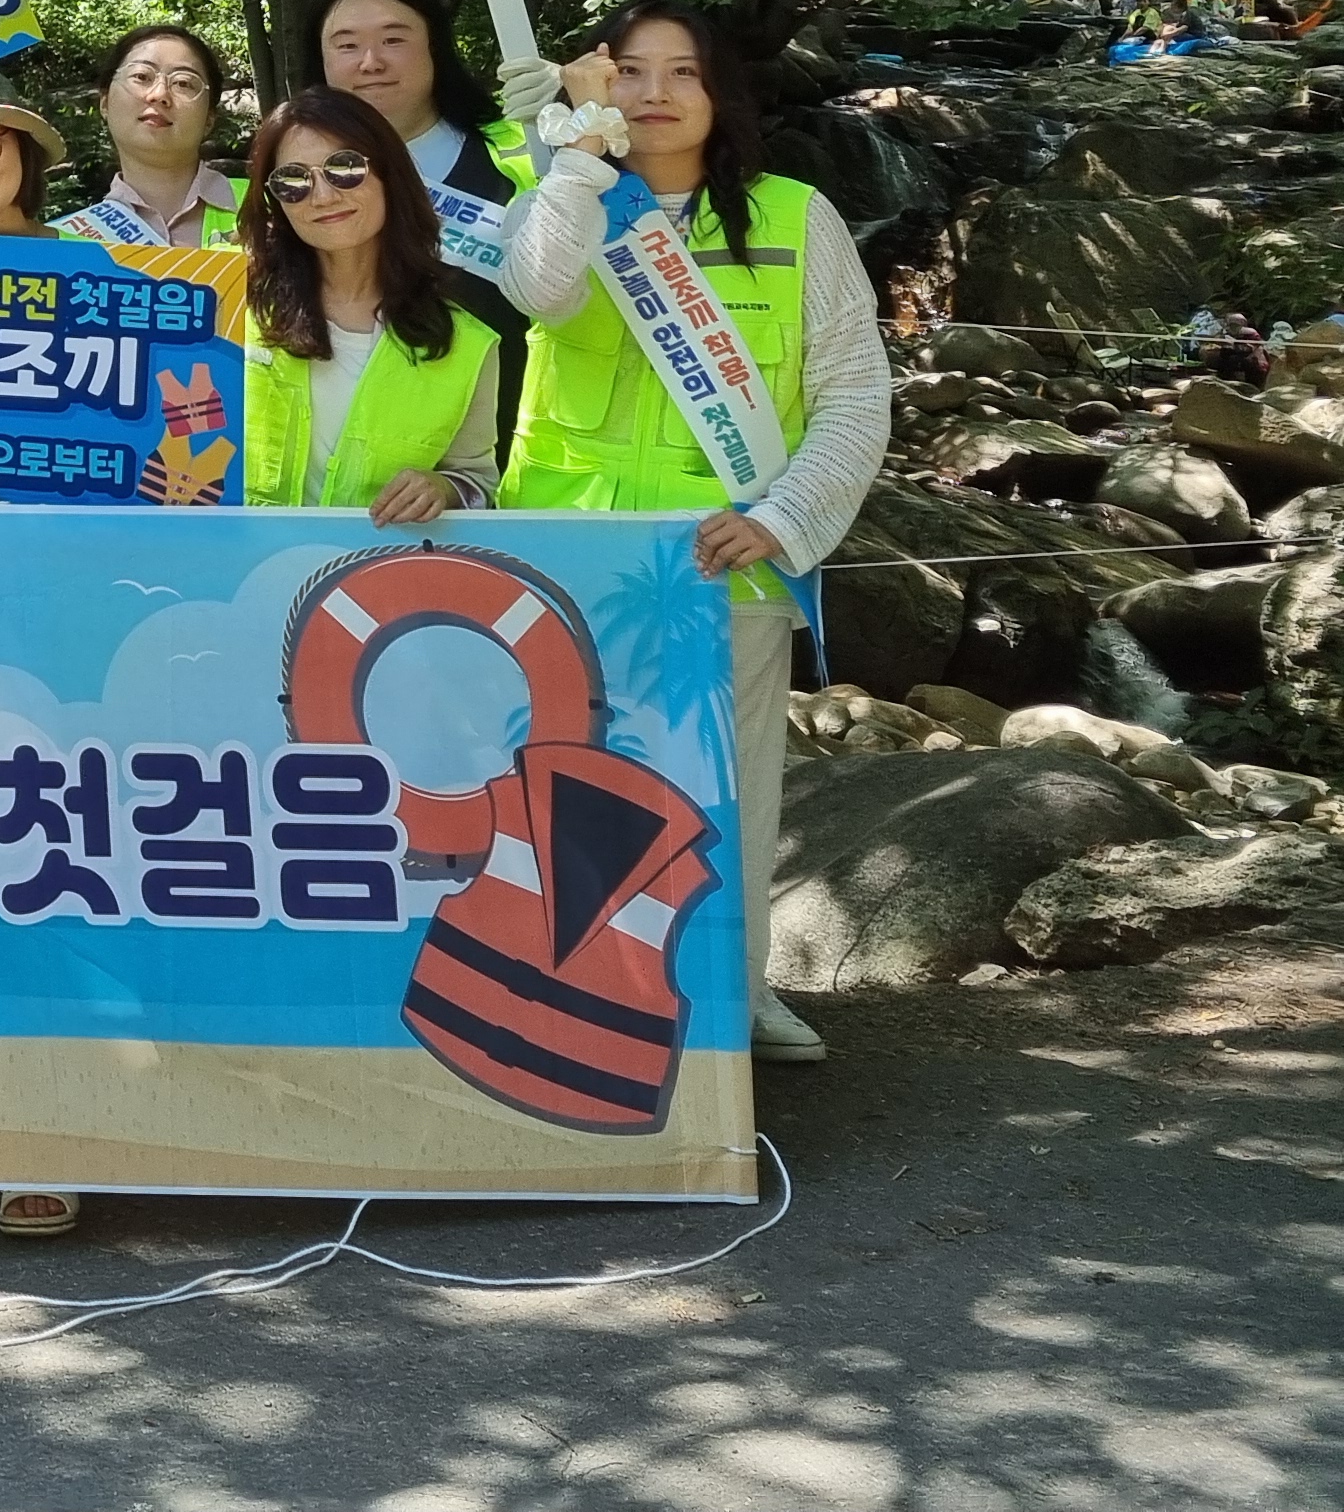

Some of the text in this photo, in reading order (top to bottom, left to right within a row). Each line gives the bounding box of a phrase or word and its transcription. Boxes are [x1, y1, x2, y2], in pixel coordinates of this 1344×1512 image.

[69, 277, 204, 330] 첫걸음!
[603, 244, 759, 486] 물놀이 안전의 첫걸음
[640, 229, 756, 411] 구명조끼 착용!
